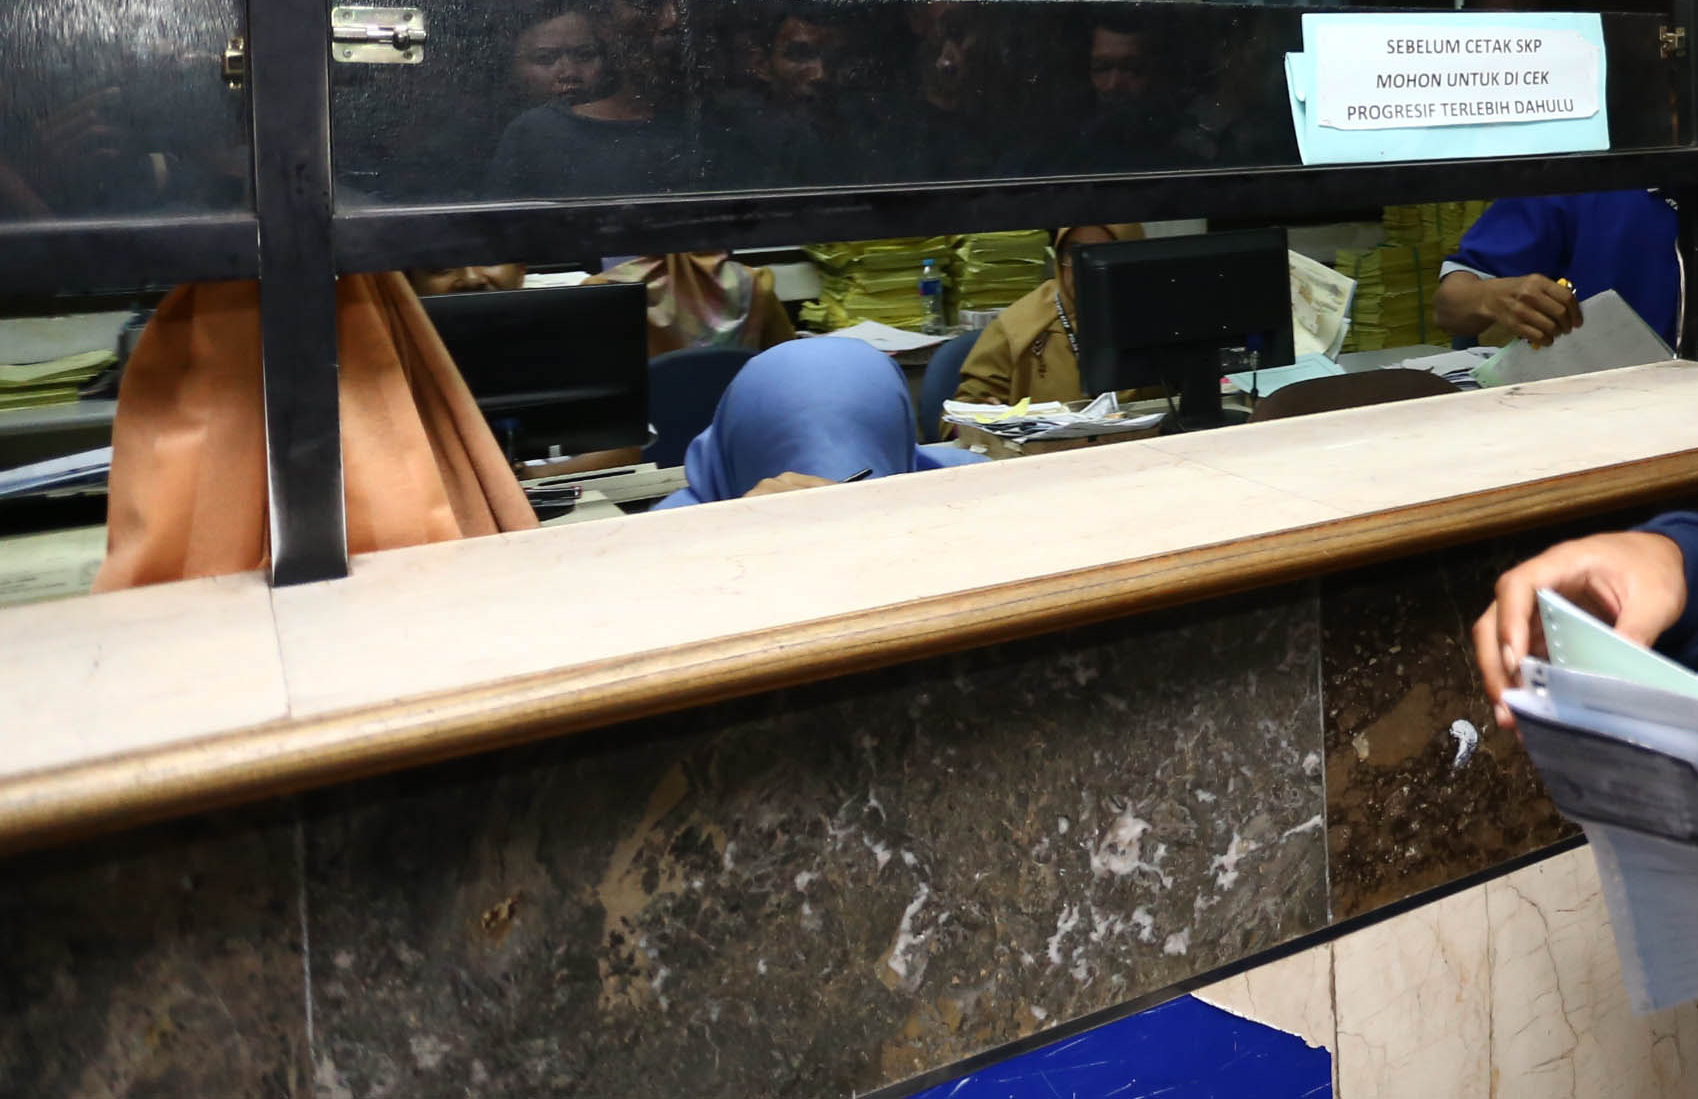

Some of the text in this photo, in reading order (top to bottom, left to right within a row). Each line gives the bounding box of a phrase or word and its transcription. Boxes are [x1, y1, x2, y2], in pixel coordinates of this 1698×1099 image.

[1386, 39, 1543, 54] SEBELUM CETAK SKP
[1376, 71, 1550, 89] MOHON UNTUK DI CEK
[1347, 99, 1575, 121] PROGRESIF TERLEBIH DAHULU
